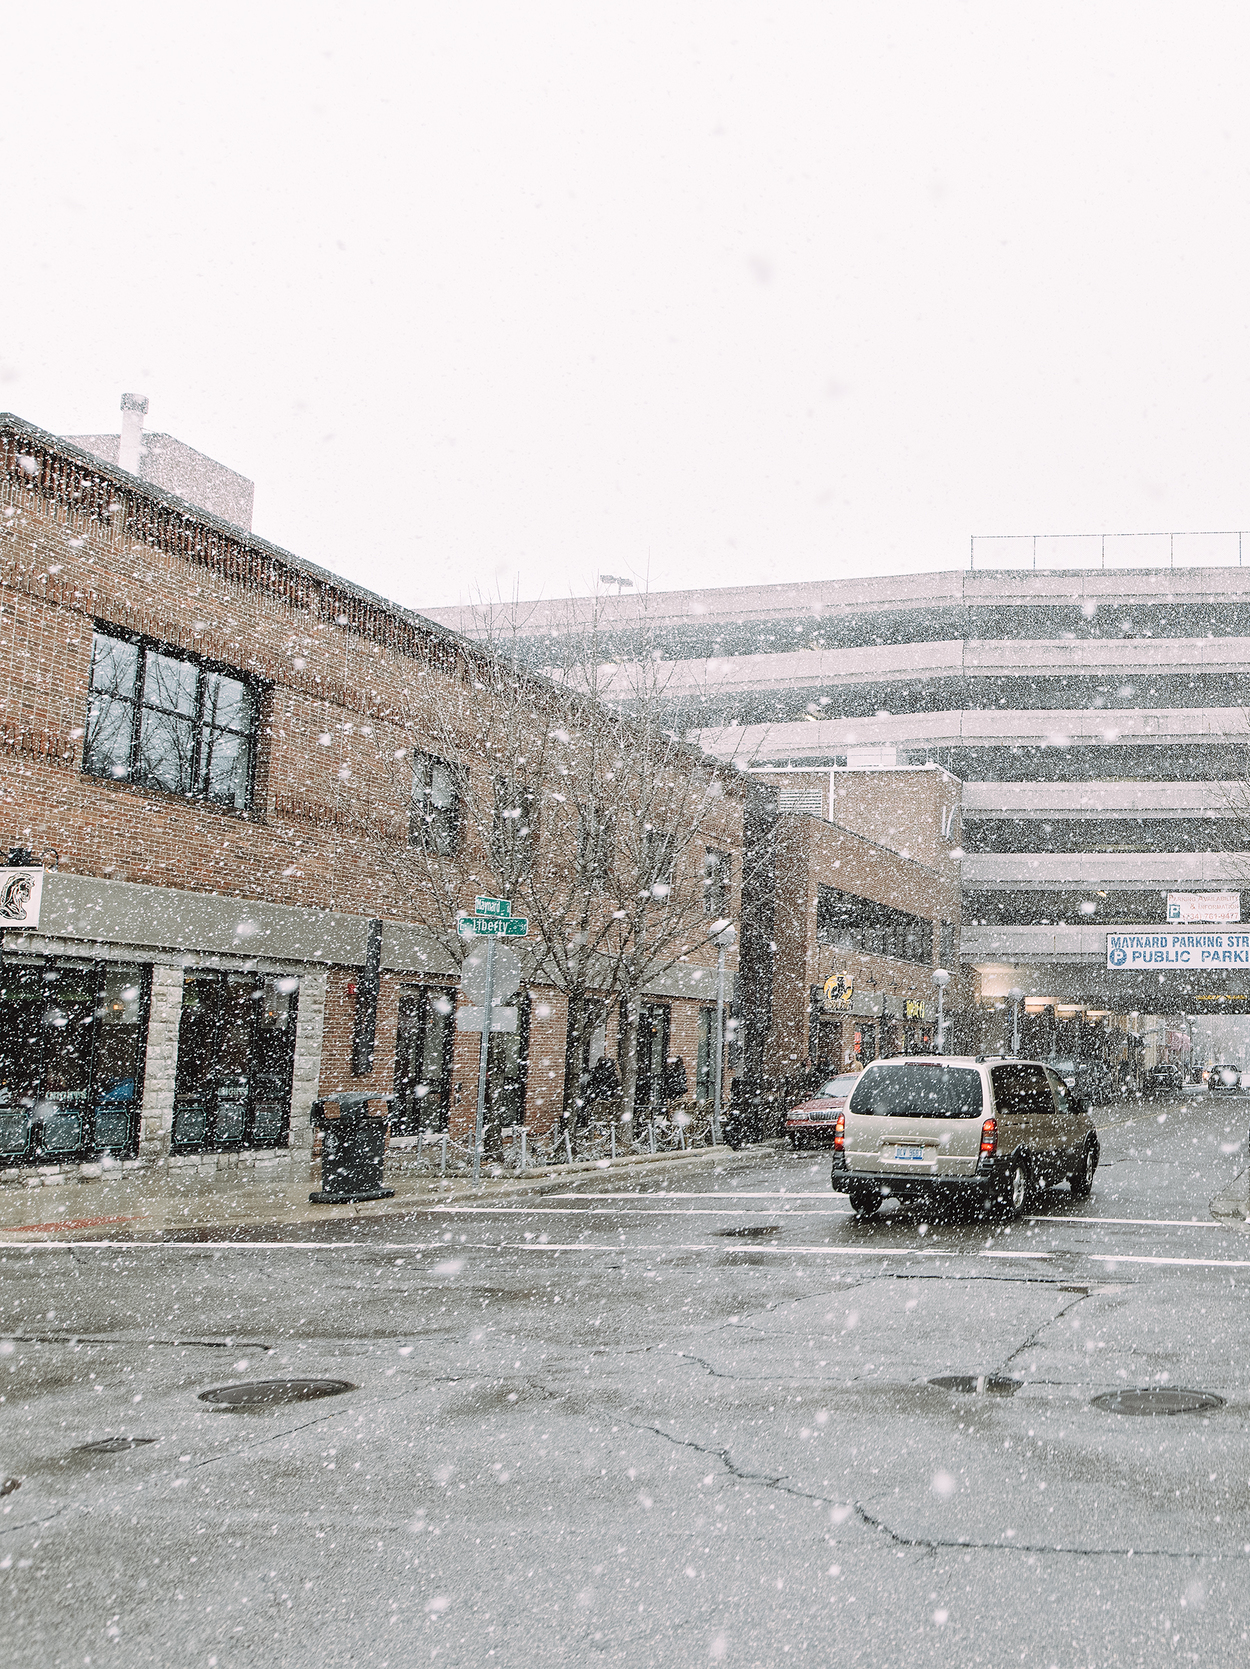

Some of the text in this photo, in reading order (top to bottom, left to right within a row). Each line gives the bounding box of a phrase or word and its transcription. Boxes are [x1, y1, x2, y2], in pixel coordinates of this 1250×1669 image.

[1168, 894, 1196, 902] PARKING
[476, 899, 501, 913] Maynard
[473, 919, 509, 936] Liberty
[1110, 936, 1168, 949] MAYNARD
[1171, 935, 1223, 948] PARKING
[1131, 950, 1191, 963] PUBLIC
